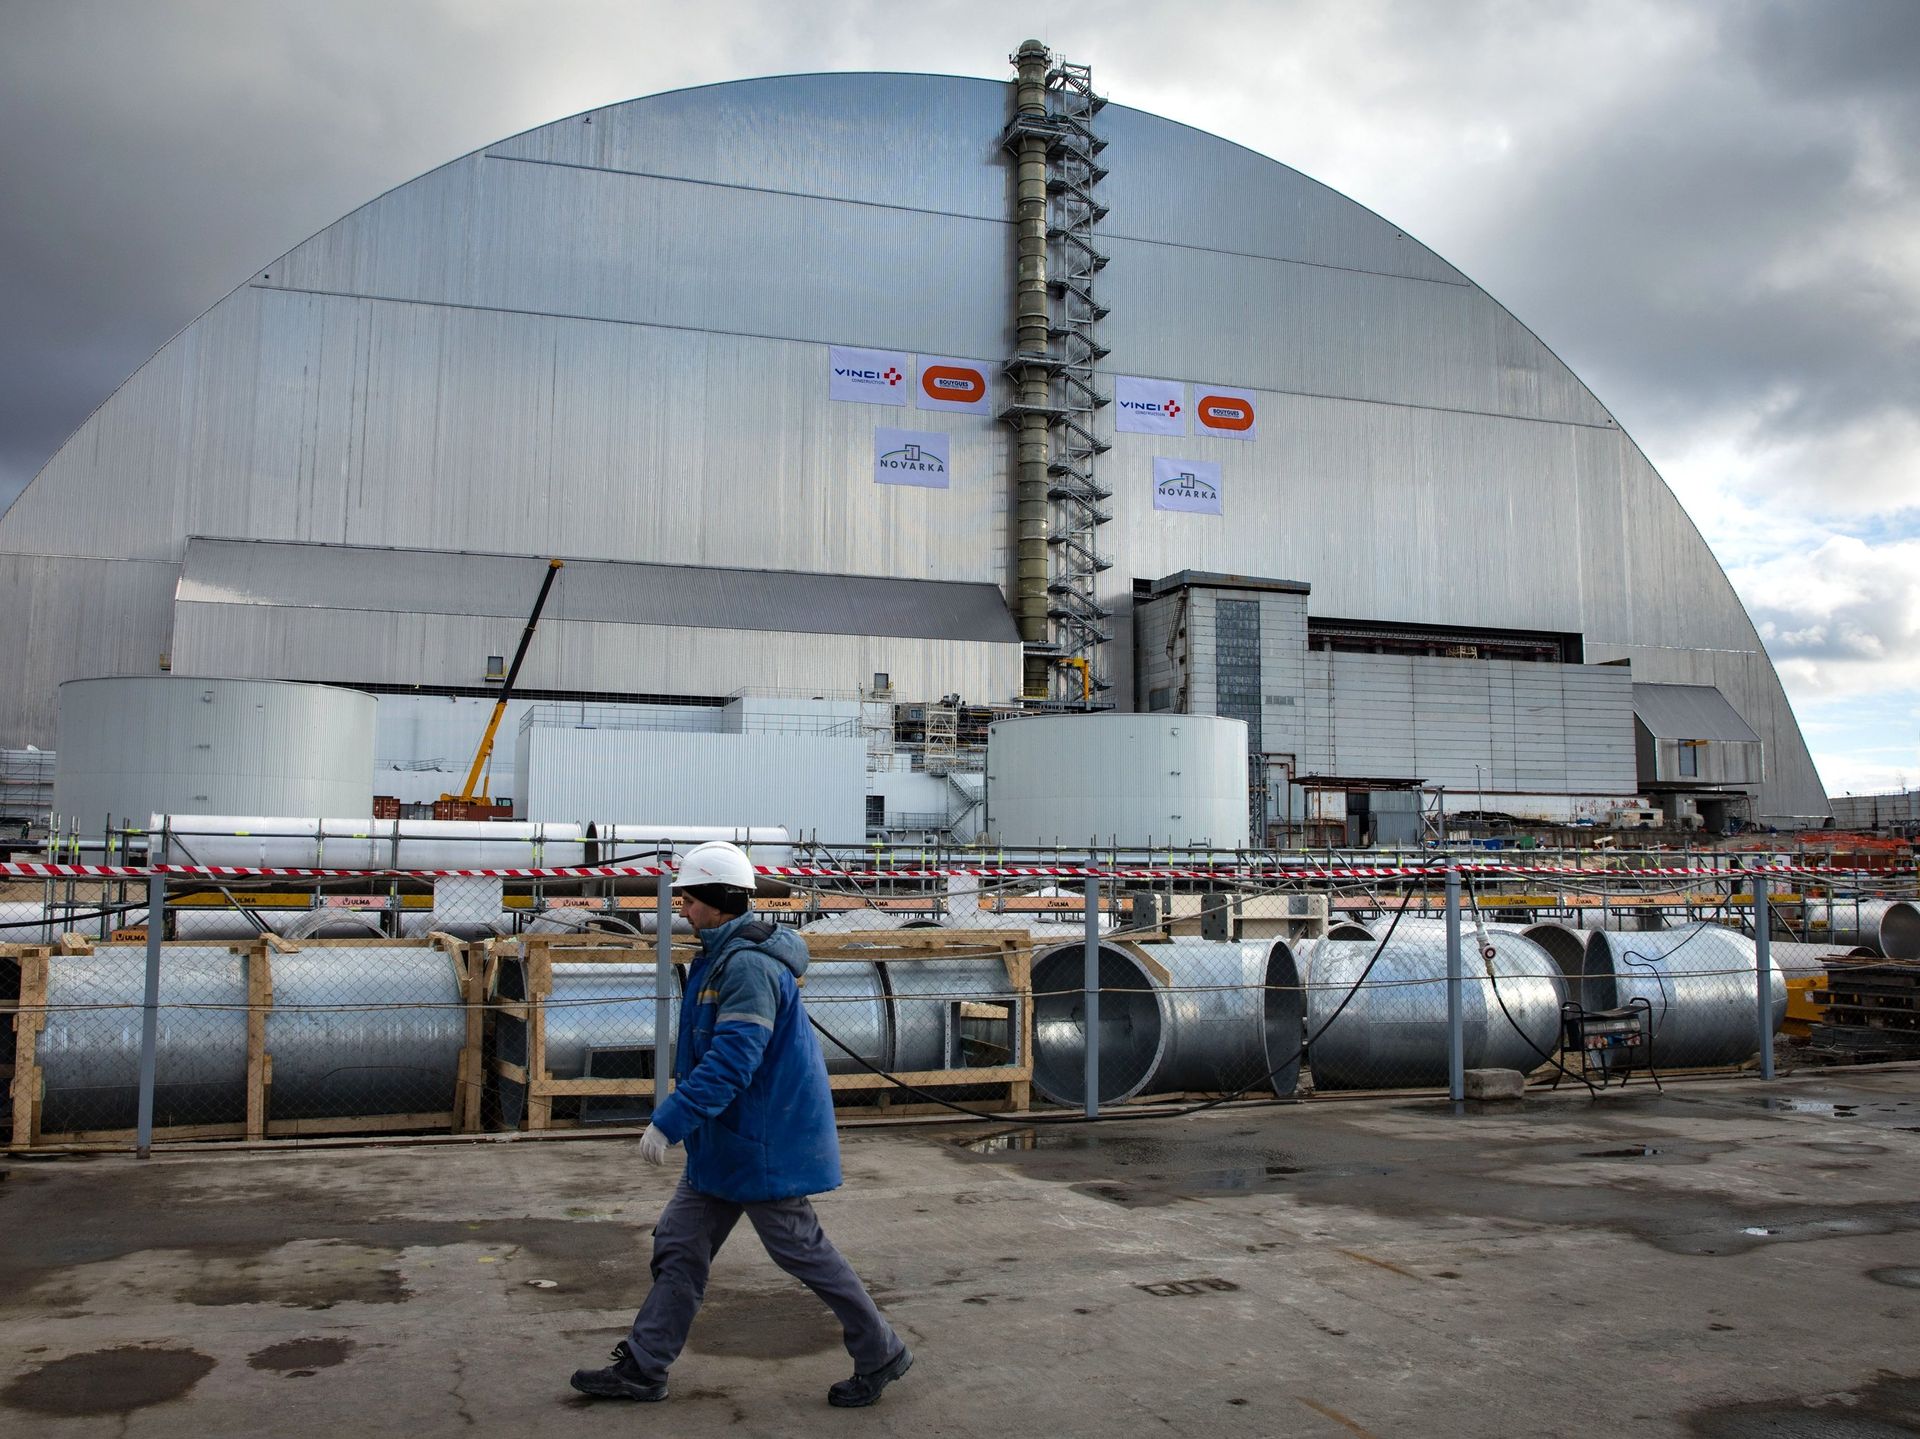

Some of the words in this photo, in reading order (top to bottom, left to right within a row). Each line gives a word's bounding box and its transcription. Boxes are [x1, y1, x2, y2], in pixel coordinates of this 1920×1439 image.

[835, 368, 880, 379] VINCI
[939, 379, 969, 388] BOUYGUES
[1120, 401, 1161, 412] VINCI
[1213, 408, 1240, 416] BOUYGUES
[880, 459, 945, 473] NOVARKA
[1158, 487, 1217, 500] NOVARKA
